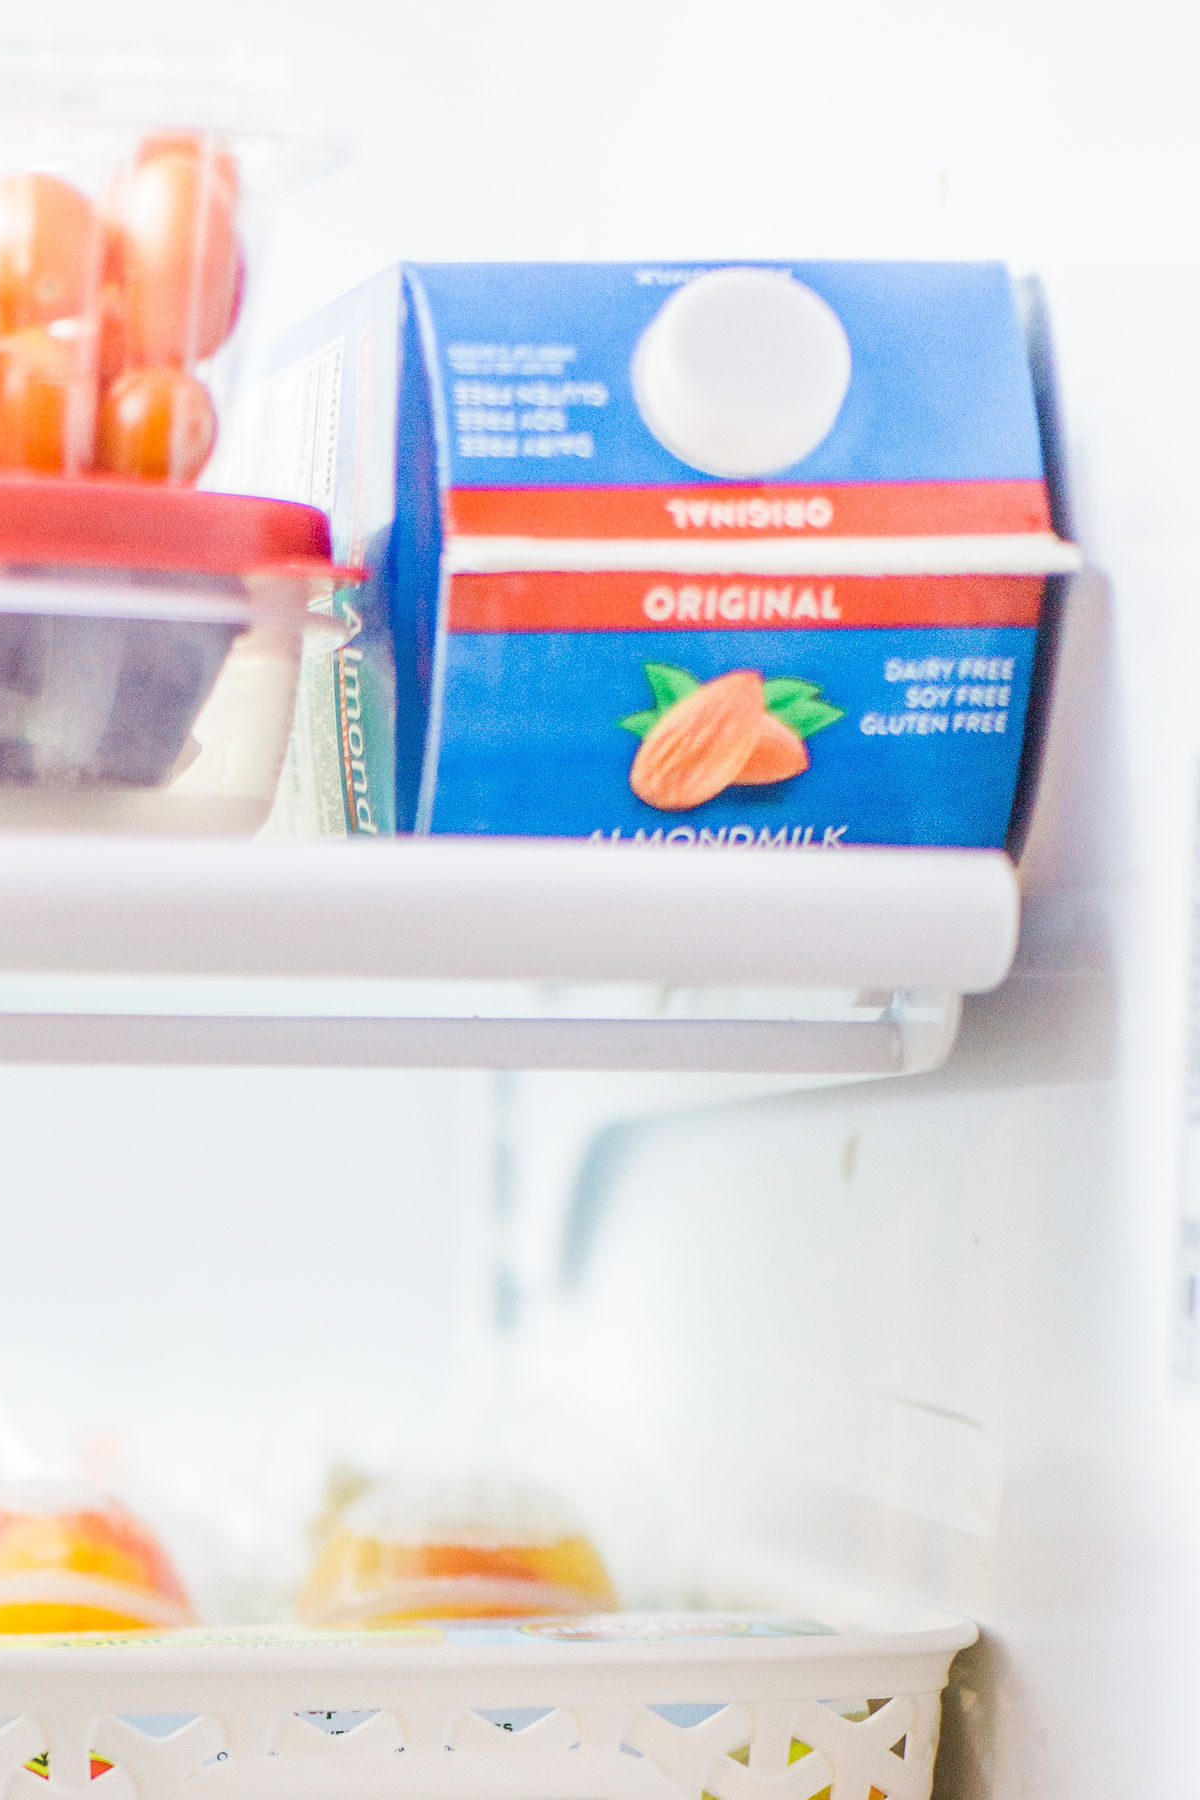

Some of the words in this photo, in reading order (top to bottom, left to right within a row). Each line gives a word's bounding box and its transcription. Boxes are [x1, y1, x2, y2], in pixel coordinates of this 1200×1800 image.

[666, 497, 834, 530] ORIGINAL
[643, 585, 842, 621] ORIGINAL
[884, 656, 955, 682] DAIRY
[958, 656, 1016, 680] FREE
[905, 684, 952, 709] SOY
[955, 685, 1012, 707] FREE
[860, 711, 948, 736] GLUTEN
[952, 710, 1009, 734] FREE
